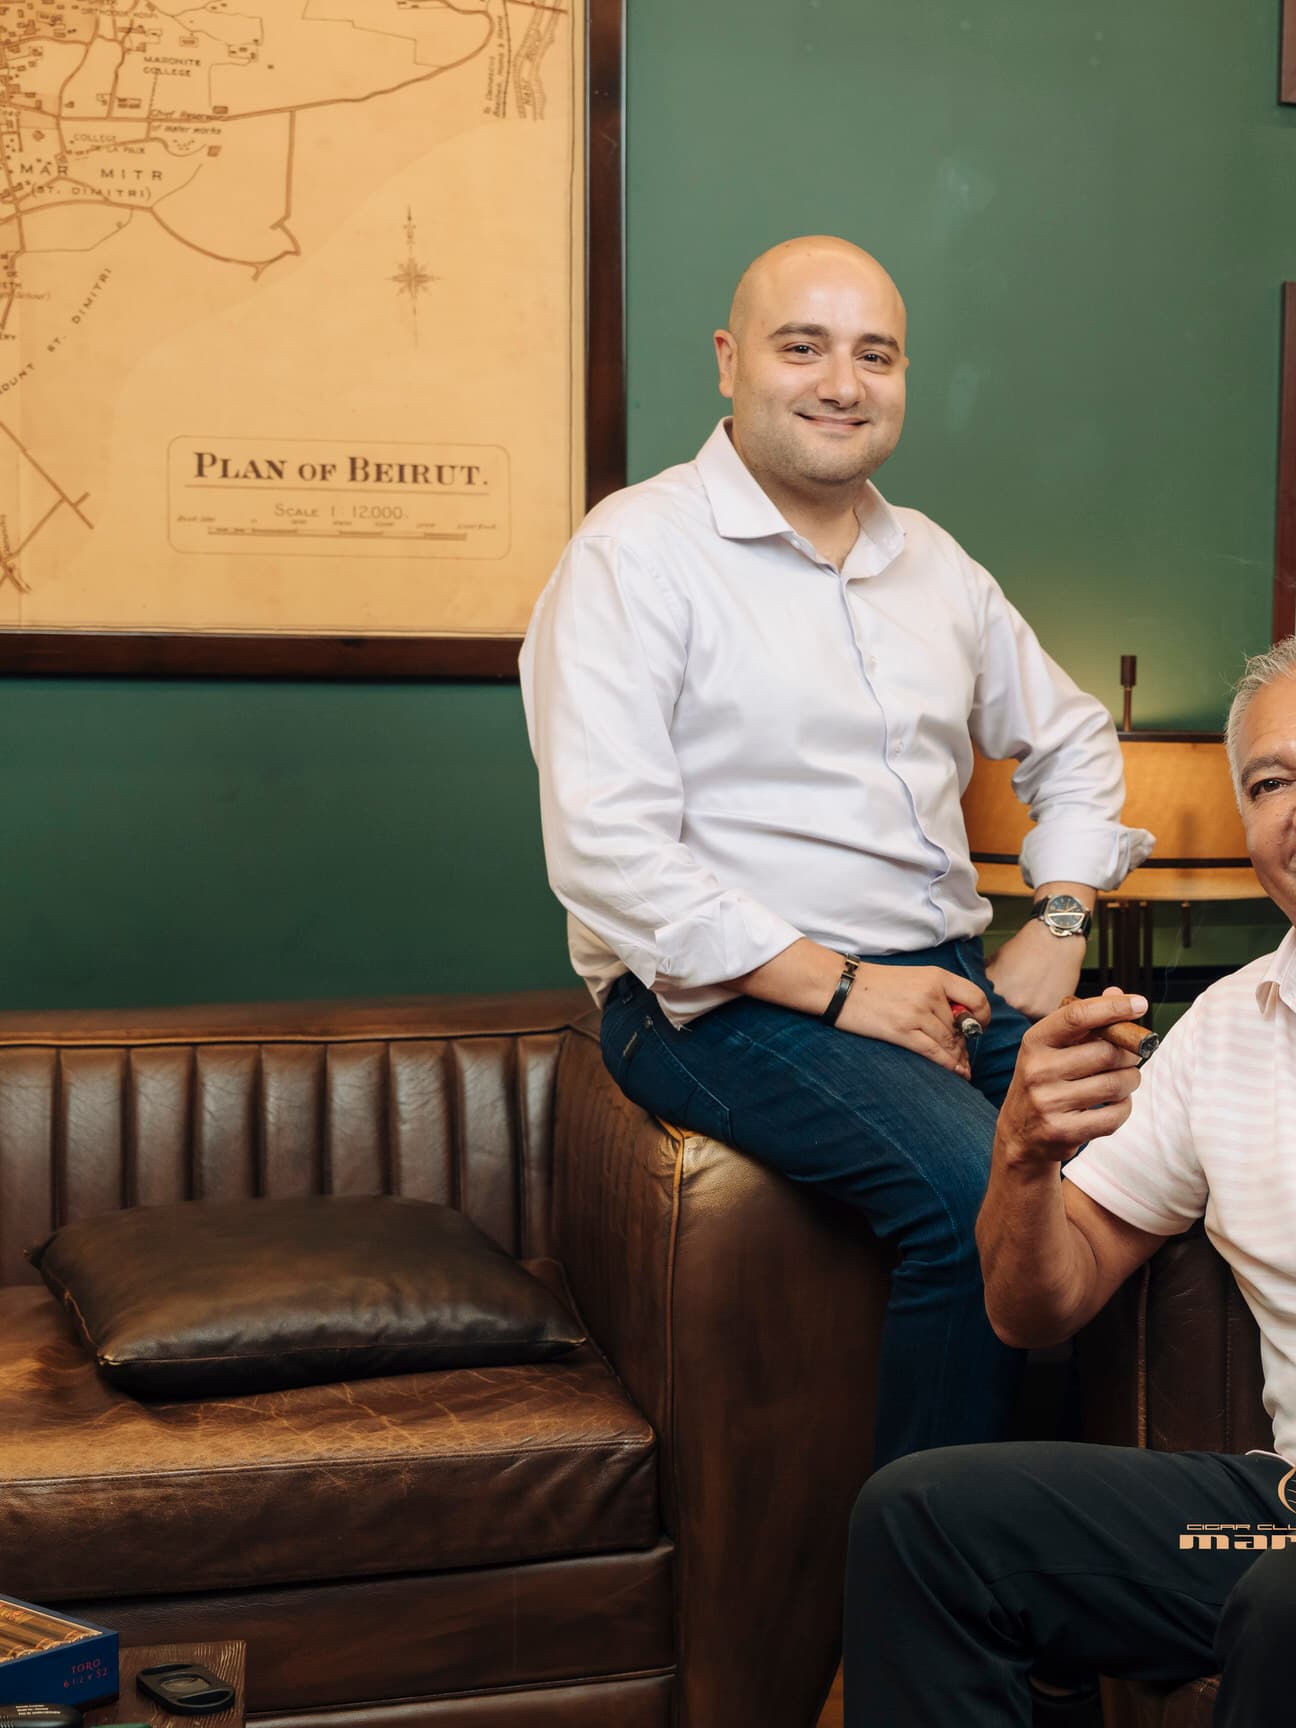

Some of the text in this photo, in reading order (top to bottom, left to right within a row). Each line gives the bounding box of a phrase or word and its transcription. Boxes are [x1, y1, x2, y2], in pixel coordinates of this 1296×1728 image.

[143, 56, 201, 66] MARONITE
[143, 67, 191, 77] COLLEGE
[20, 163, 163, 181] MAR MITR
[71, 267, 112, 325] DIMITRI
[194, 451, 489, 486] PLAN OF BEIRUT.
[273, 503, 320, 518] SCALE
[71, 1658, 101, 1673] TORO
